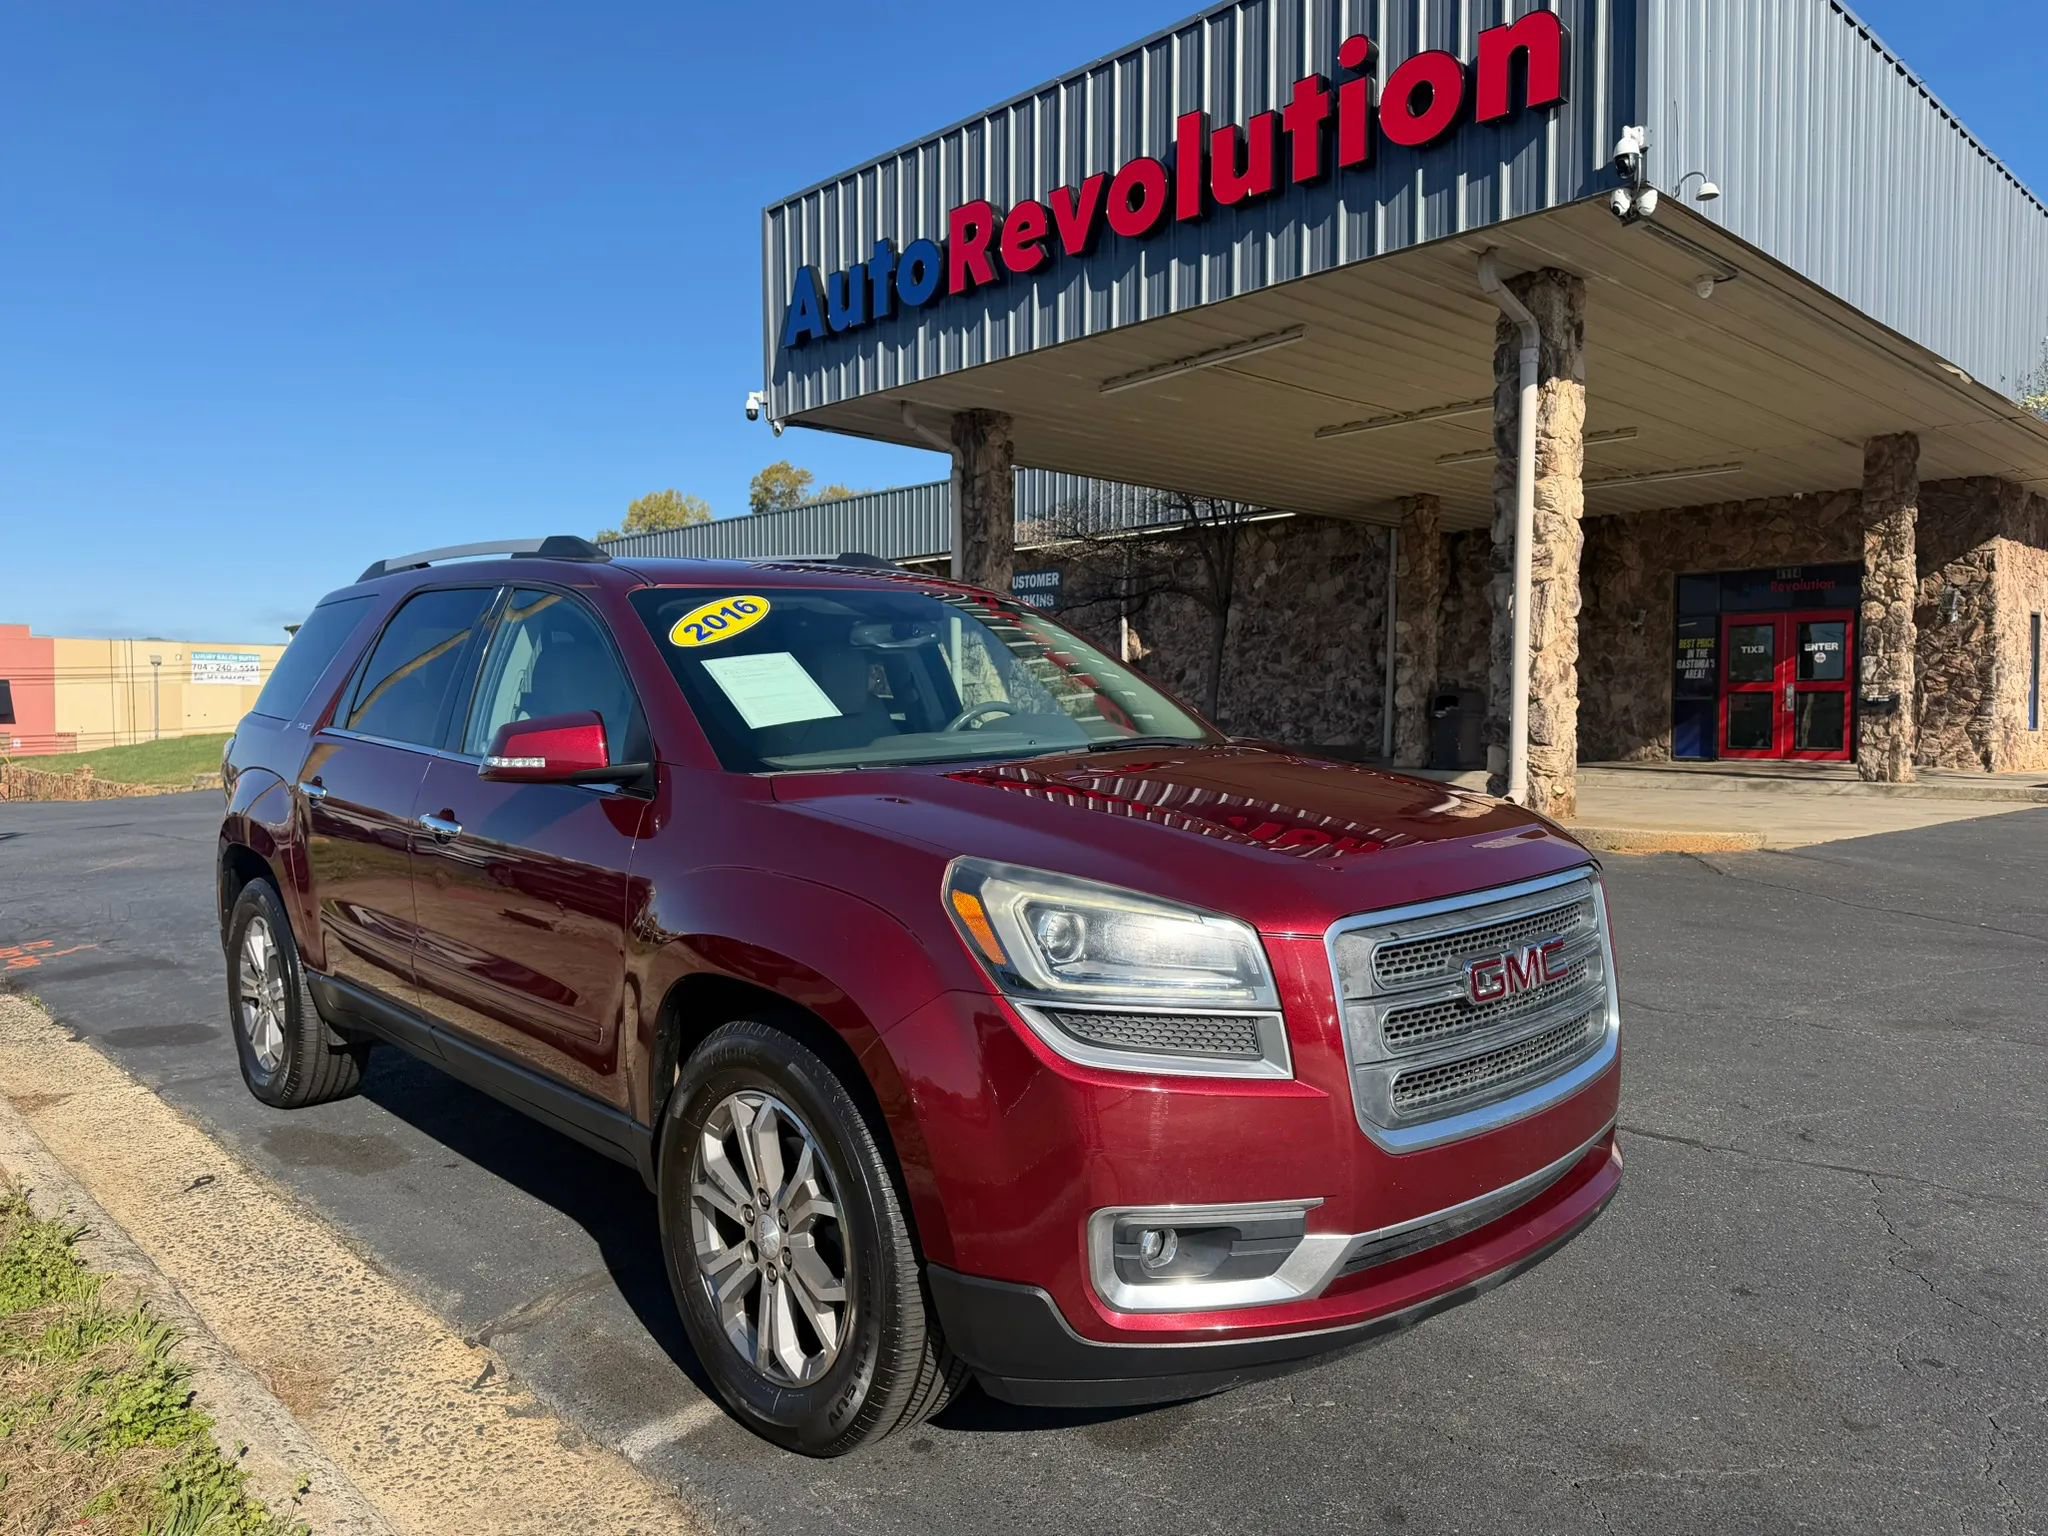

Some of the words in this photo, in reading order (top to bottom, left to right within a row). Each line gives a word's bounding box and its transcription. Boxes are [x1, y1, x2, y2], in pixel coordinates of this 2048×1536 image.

[782, 10, 1570, 349] AutoRevolution
[1012, 572, 1060, 589] USTOMER
[684, 600, 758, 641] 2016
[1679, 639, 1696, 648] BEST
[1804, 642, 1839, 652] ENTER
[1696, 649, 1708, 658] THE
[1463, 935, 1569, 1005] GMC
